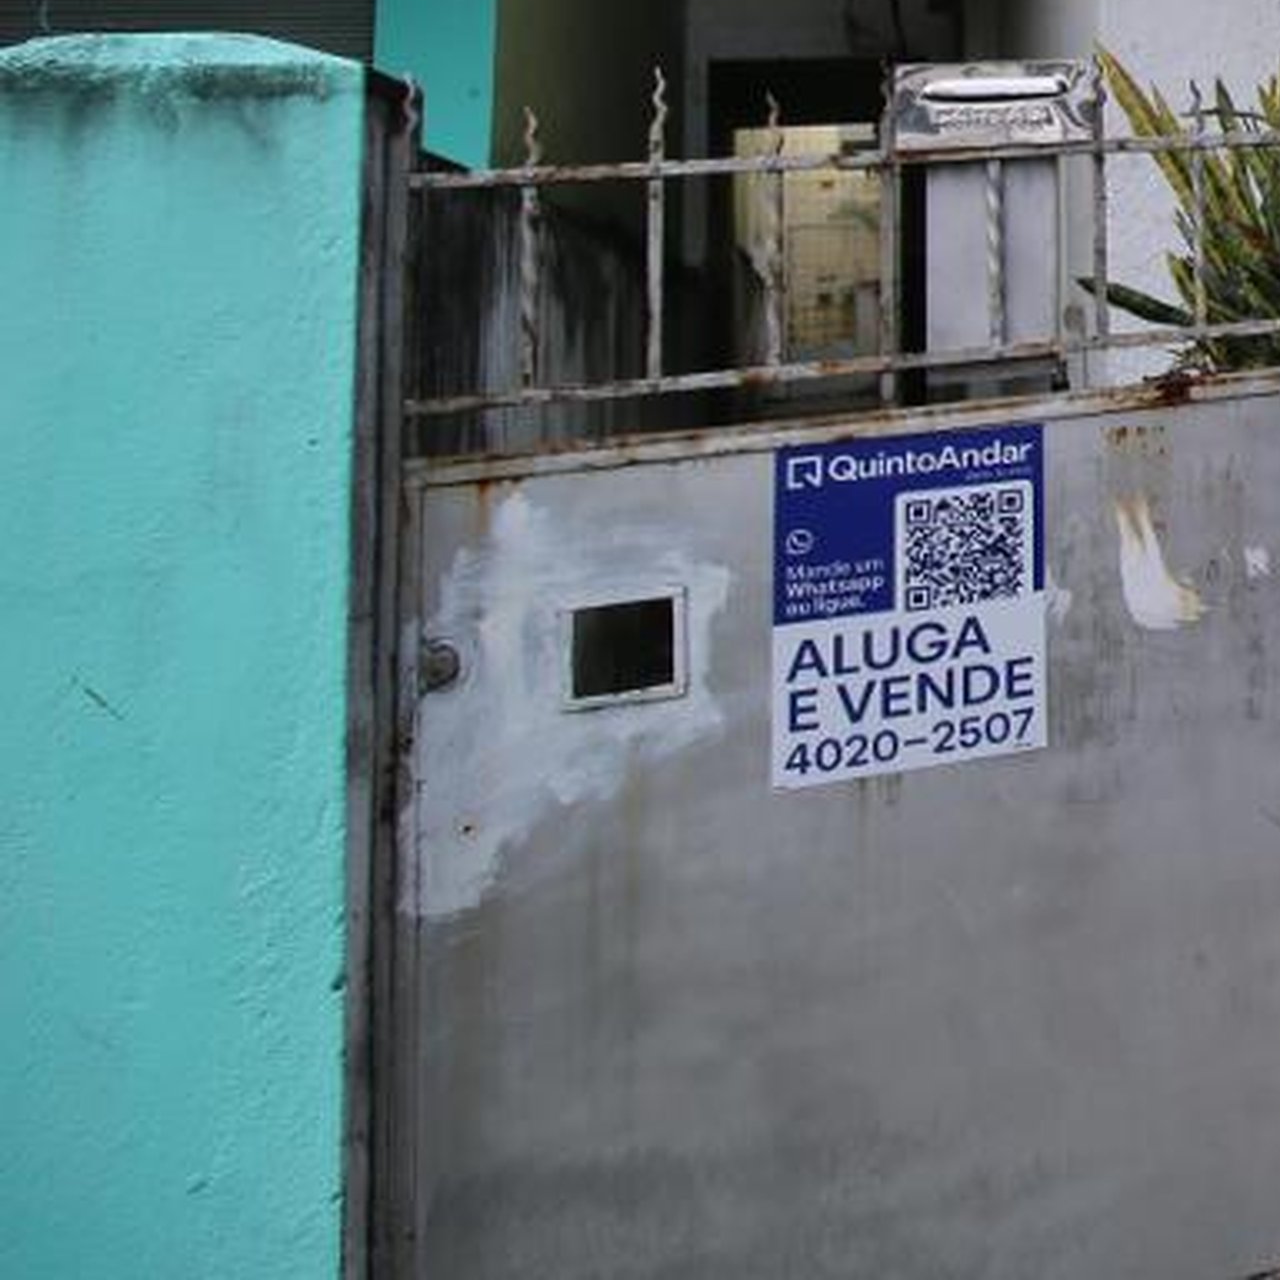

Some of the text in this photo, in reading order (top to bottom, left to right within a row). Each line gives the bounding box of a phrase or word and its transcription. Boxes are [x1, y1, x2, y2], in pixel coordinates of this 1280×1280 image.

[828, 439, 1033, 482] QuintoAndar
[786, 616, 990, 684] ALUGA
[788, 656, 1034, 733] E VENDE
[784, 707, 1034, 775] 4020-2507
